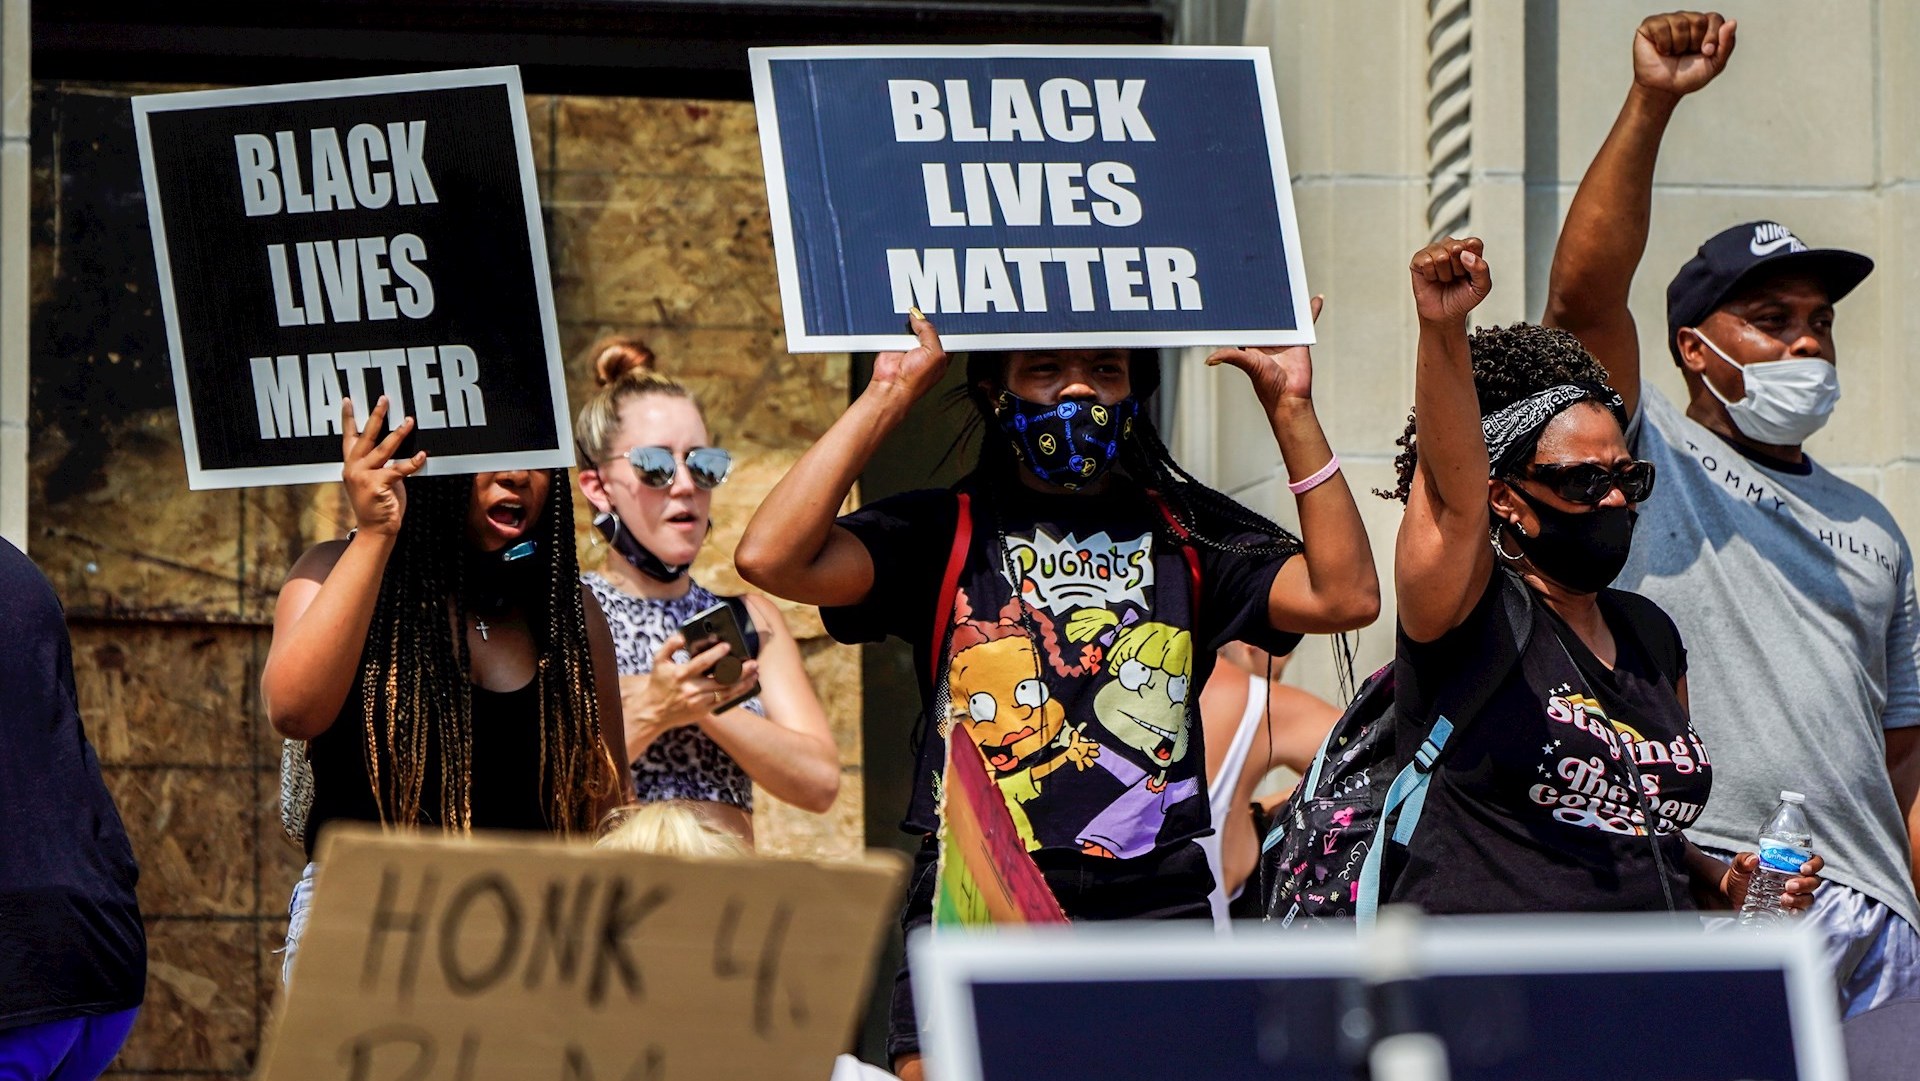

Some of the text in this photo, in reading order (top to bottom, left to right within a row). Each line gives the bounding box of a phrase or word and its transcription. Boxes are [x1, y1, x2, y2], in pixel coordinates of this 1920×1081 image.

[888, 78, 1156, 142] BLACK
[234, 120, 439, 217] BLACK
[921, 161, 1143, 227] LIVES
[267, 233, 435, 327] LIVES
[886, 247, 1203, 314] MATTER
[249, 344, 488, 440] MATTER
[1685, 440, 1785, 511] TOMMY
[1819, 529, 1896, 582] HILFIG
[1557, 756, 1629, 803] The
[360, 860, 675, 1014] HONK
